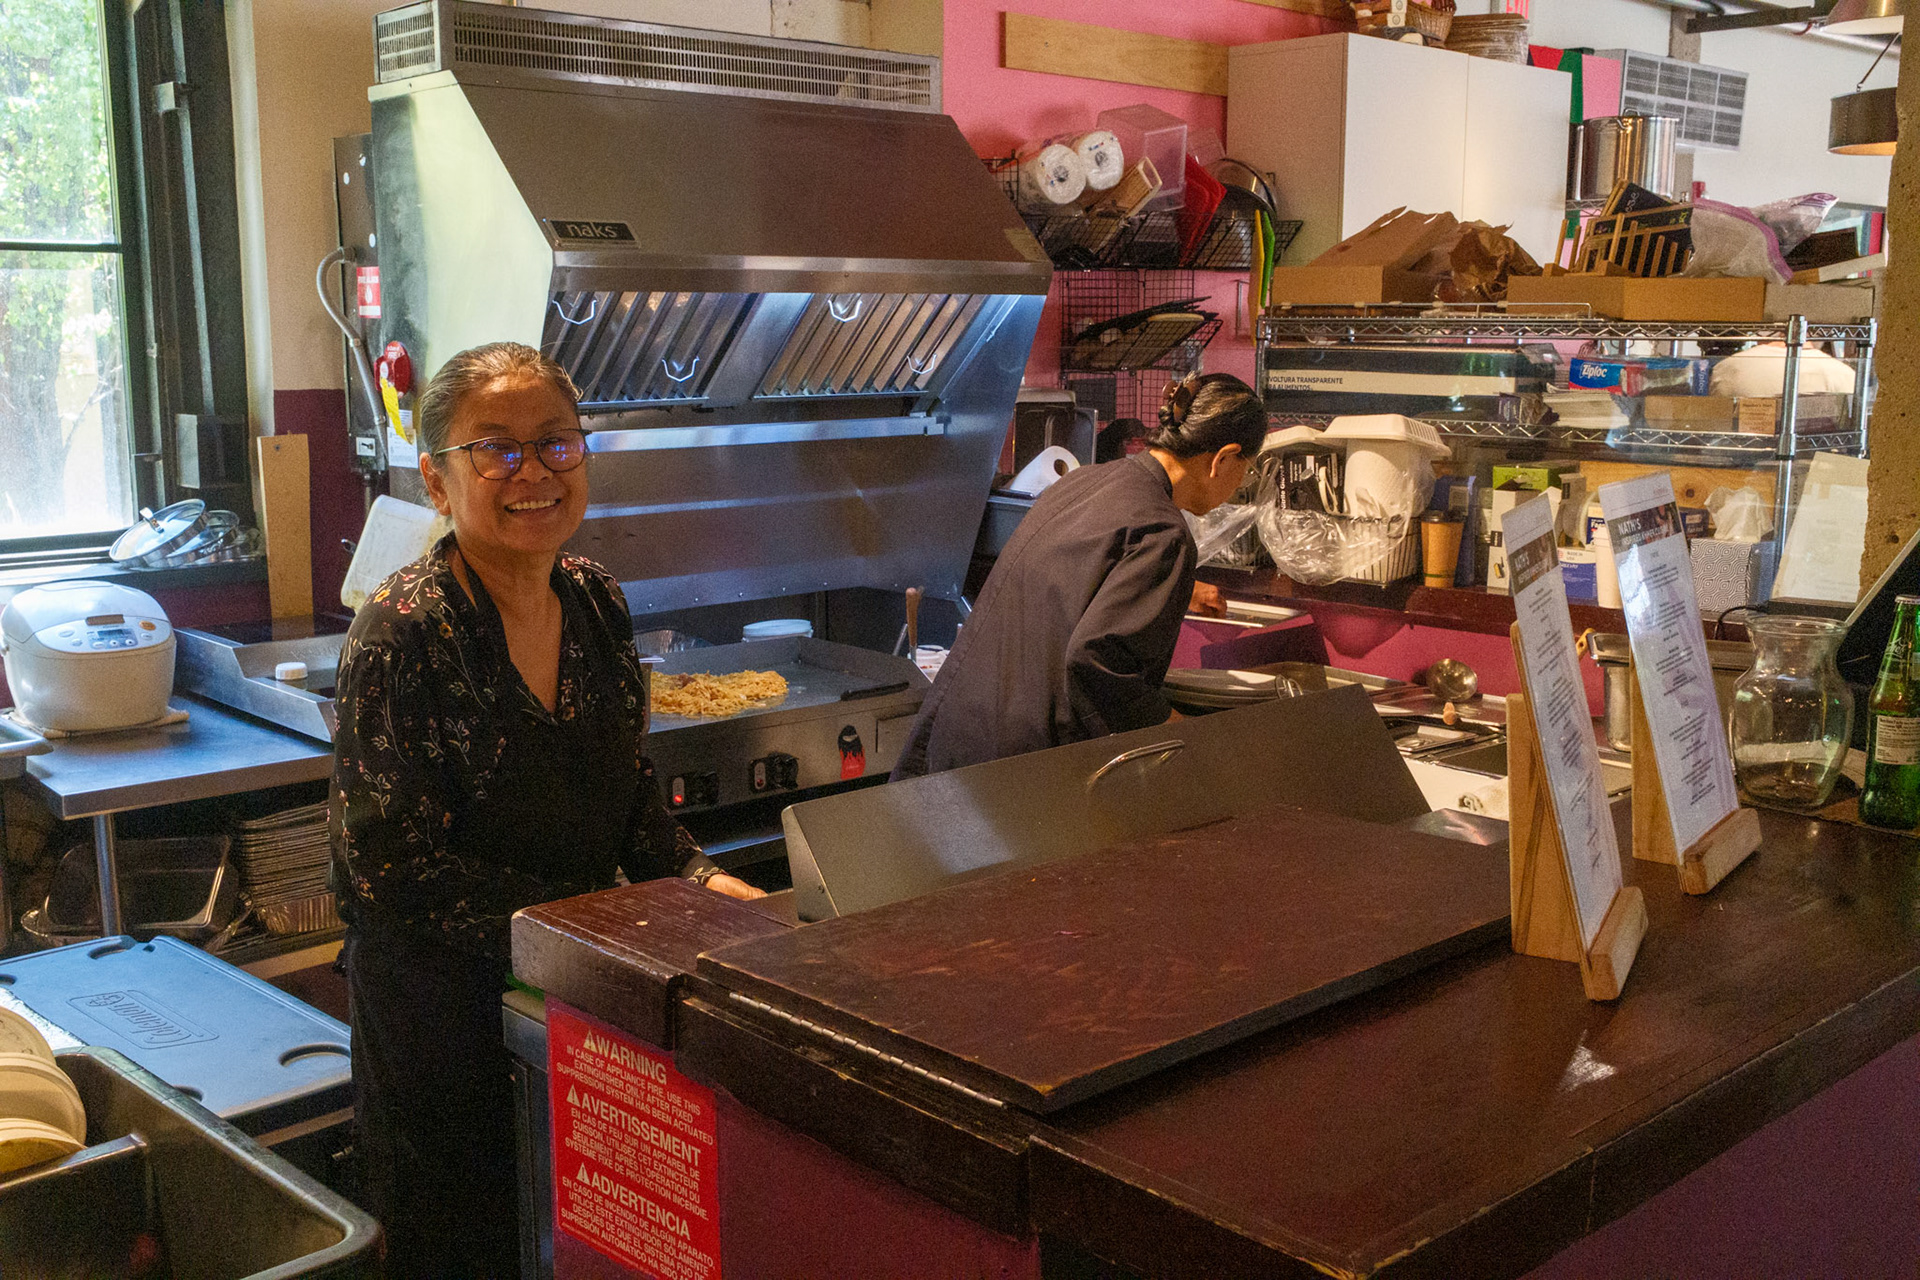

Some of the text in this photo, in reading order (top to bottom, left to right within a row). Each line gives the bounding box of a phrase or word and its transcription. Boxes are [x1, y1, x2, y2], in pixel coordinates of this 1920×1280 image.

[566, 221, 617, 238] naks
[1582, 364, 1608, 379] Ziploc
[575, 1047, 593, 1064] CASE
[595, 1056, 604, 1070] OF
[606, 1062, 646, 1089] APPLIANCE
[667, 1090, 681, 1107] USE
[684, 1098, 700, 1116] THIS
[597, 1034, 667, 1085] WARNING
[556, 1061, 713, 1146] SUPPRESSION SYSTEM HAS BEEN ACTUATED
[575, 1058, 692, 1123] EXTINGUISHER ONLY AFTER FIXED
[571, 1106, 699, 1181] EN CAS DE FEU SUR UN APPAREIL DE
[581, 1092, 701, 1167] AVERTISSEMENT
[572, 1128, 613, 1160] SEULEMENT
[689, 1190, 700, 1204] DU
[598, 1153, 612, 1170] FIXE
[614, 1161, 624, 1176] DE
[626, 1169, 671, 1199] PROTECTION
[606, 1134, 636, 1160] UTILISEZ
[637, 1151, 651, 1168] CET
[653, 1161, 698, 1191] EXTINCTEUR
[562, 1175, 571, 1189] EN
[573, 1181, 592, 1200] CASO
[594, 1193, 602, 1206] DE
[605, 1198, 637, 1225] INCENDIO
[639, 1217, 649, 1231] DE
[568, 1189, 594, 1212] UTILICE
[595, 1204, 612, 1222] ESTE
[614, 1214, 661, 1250] EXTINGUIDOR
[591, 1168, 690, 1241] ADVERTENCIA
[605, 1221, 615, 1234] DE
[616, 1227, 631, 1244] QUE
[633, 1236, 642, 1250] EL
[643, 1243, 674, 1268] SISTEMA
[676, 1261, 693, 1279] FIJO
[648, 1256, 658, 1270] HA
[660, 1263, 677, 1280] SIDO
